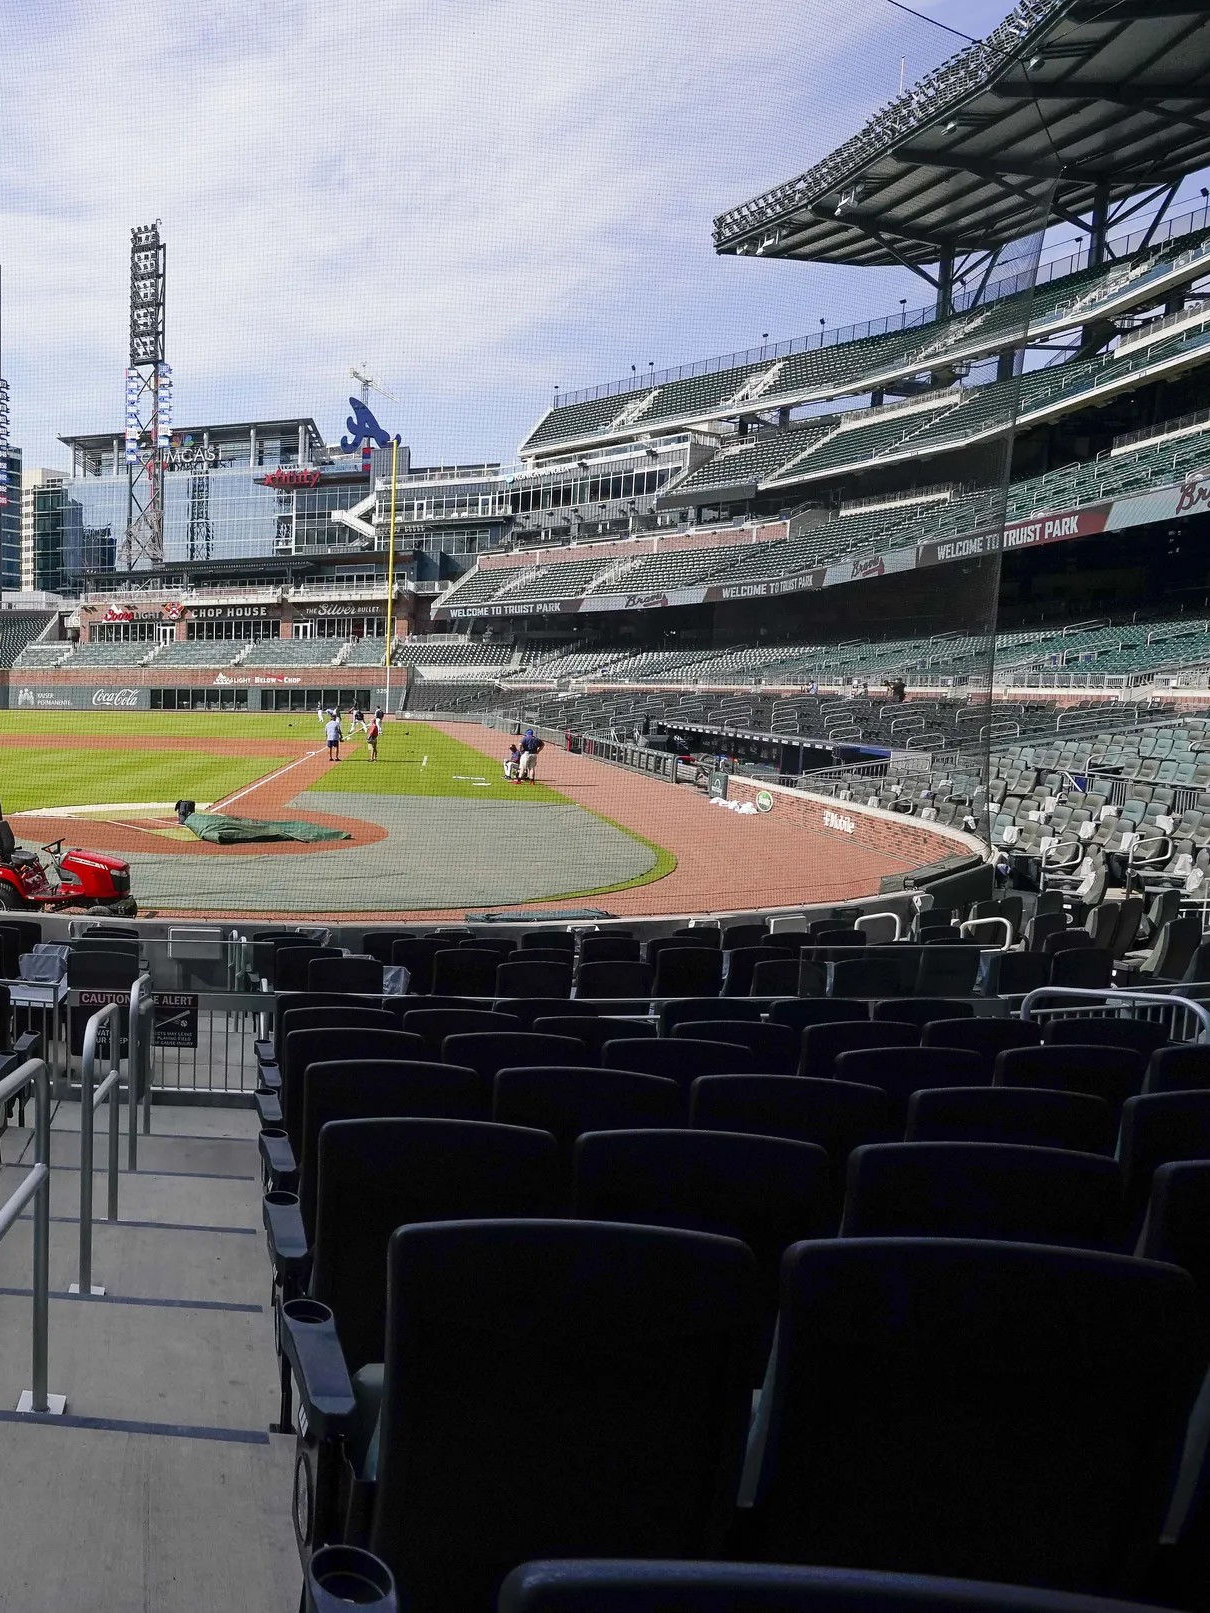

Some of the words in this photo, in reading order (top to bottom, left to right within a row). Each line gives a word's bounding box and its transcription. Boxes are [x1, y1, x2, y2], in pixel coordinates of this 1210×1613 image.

[264, 468, 321, 486] xfinity
[937, 539, 983, 561] WELCOME
[1003, 524, 1040, 548] TRUIST
[1045, 515, 1079, 541] PARK
[722, 586, 767, 598] WELCOME
[104, 609, 134, 621] Coors
[134, 612, 160, 620] LIGHT
[191, 607, 222, 618] CHOP
[227, 607, 267, 617] HOUSE
[318, 604, 356, 616] Silver
[450, 607, 489, 617] WELCOME
[491, 606, 501, 615] TO
[503, 604, 534, 614] TRUIST
[536, 602, 561, 613] PARK
[81, 993, 131, 1004] CAUTION
[163, 996, 193, 1005] ALERT
